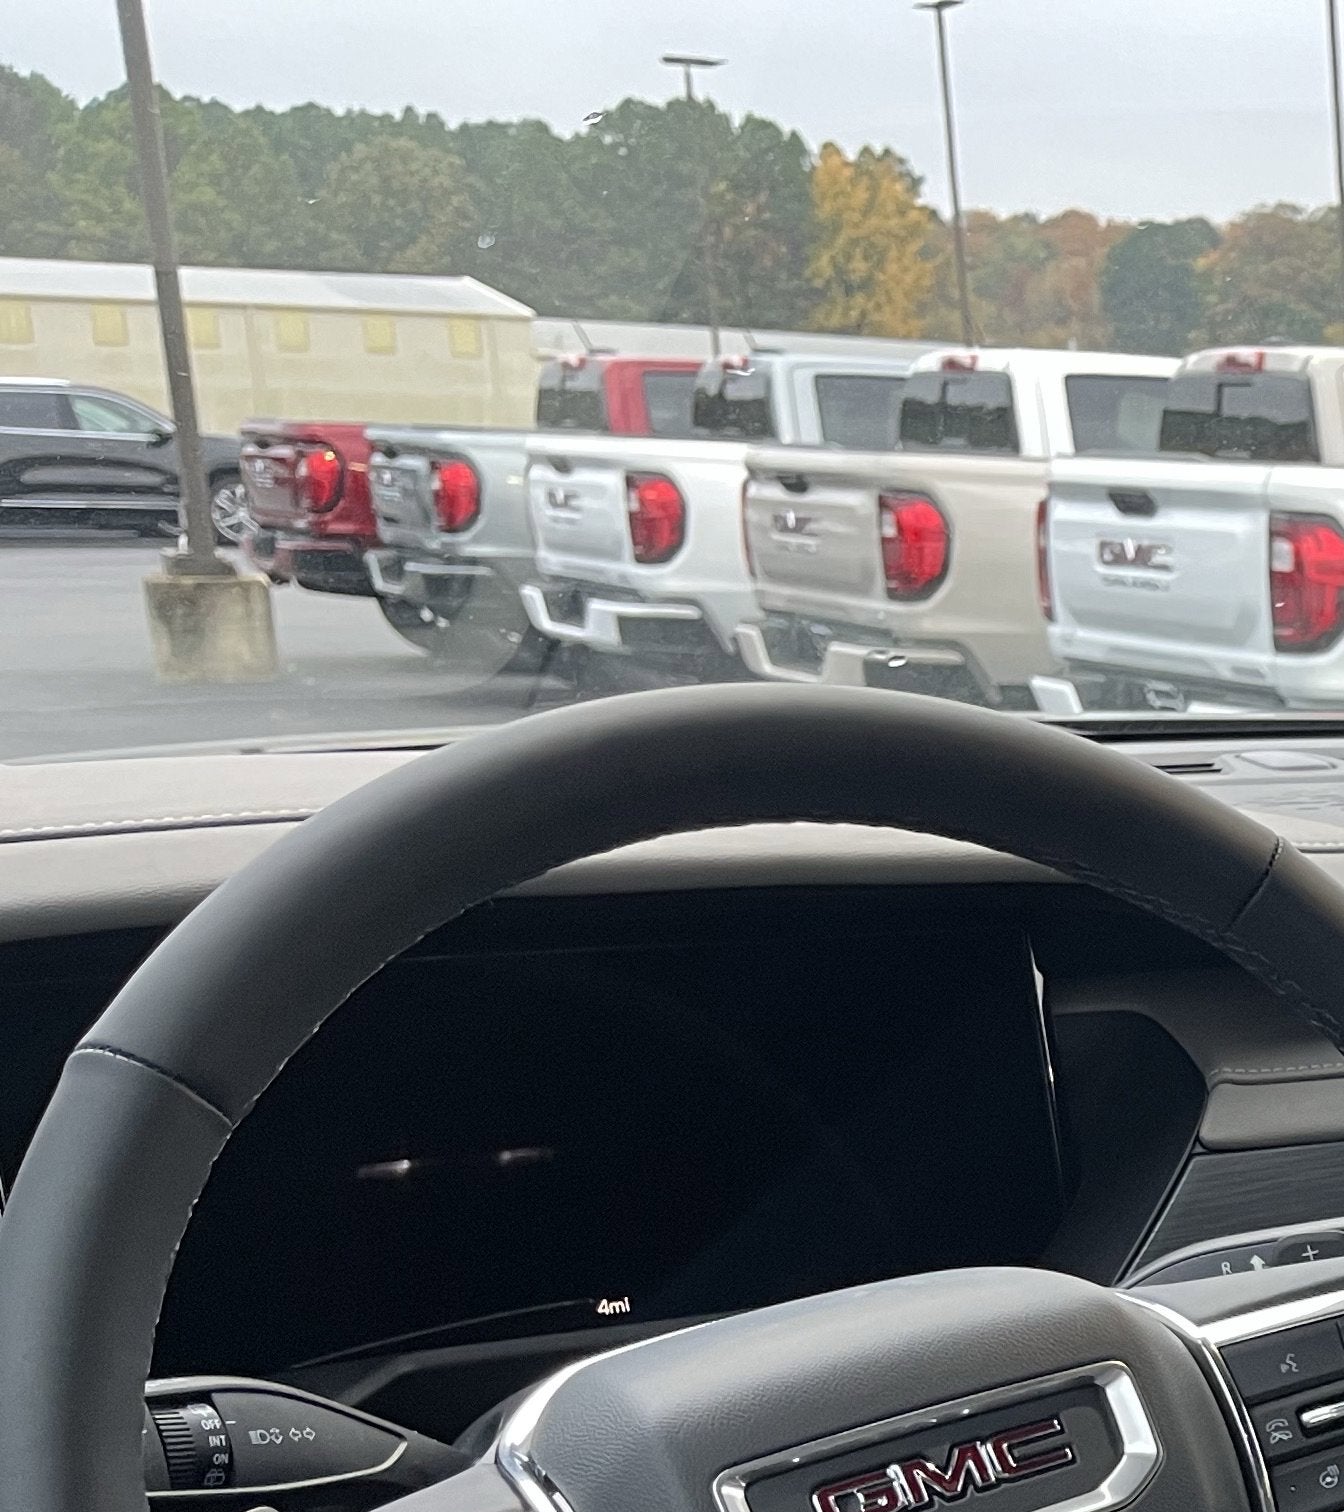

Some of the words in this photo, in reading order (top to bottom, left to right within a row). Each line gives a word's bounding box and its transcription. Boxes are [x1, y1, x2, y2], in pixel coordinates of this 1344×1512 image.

[597, 1296, 631, 1316] 4mi
[200, 1419, 221, 1431] OFF
[208, 1434, 227, 1448] INT
[212, 1453, 229, 1465] ON
